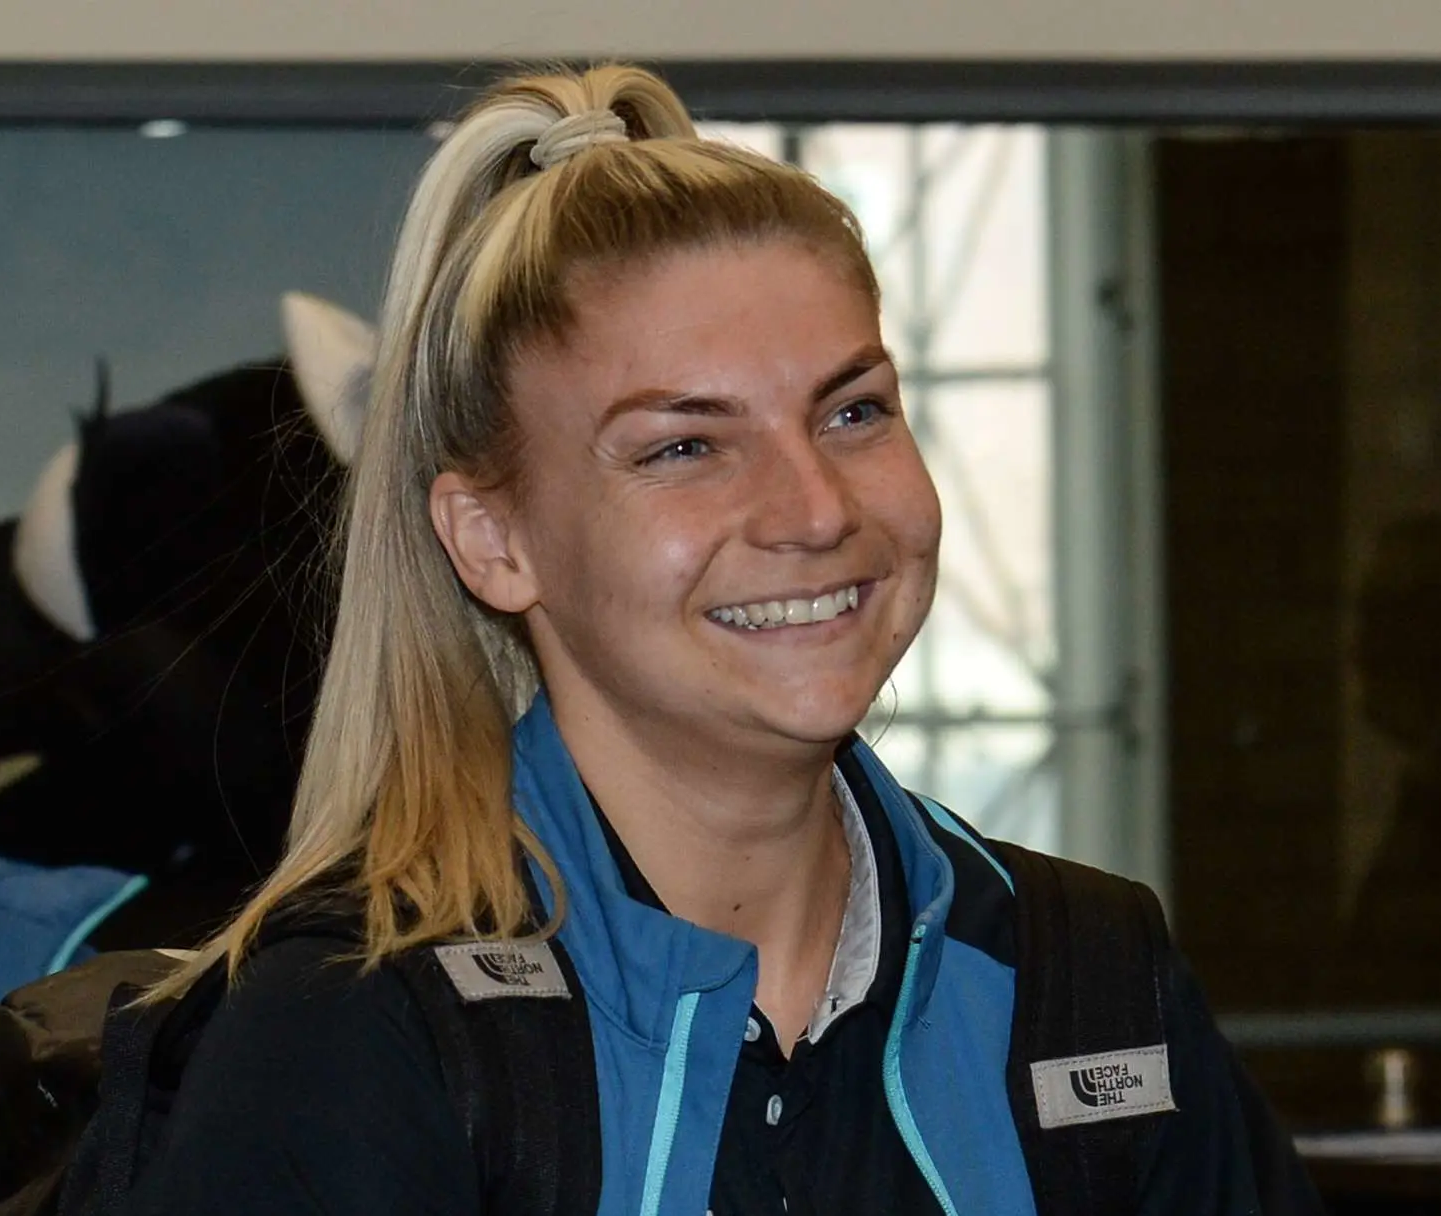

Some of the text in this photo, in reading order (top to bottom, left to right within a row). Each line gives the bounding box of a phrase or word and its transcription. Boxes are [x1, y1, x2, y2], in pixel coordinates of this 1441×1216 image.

[1095, 1063, 1128, 1080] FACE
[1098, 1074, 1143, 1092] NORTH
[1099, 1091, 1126, 1106] THE
